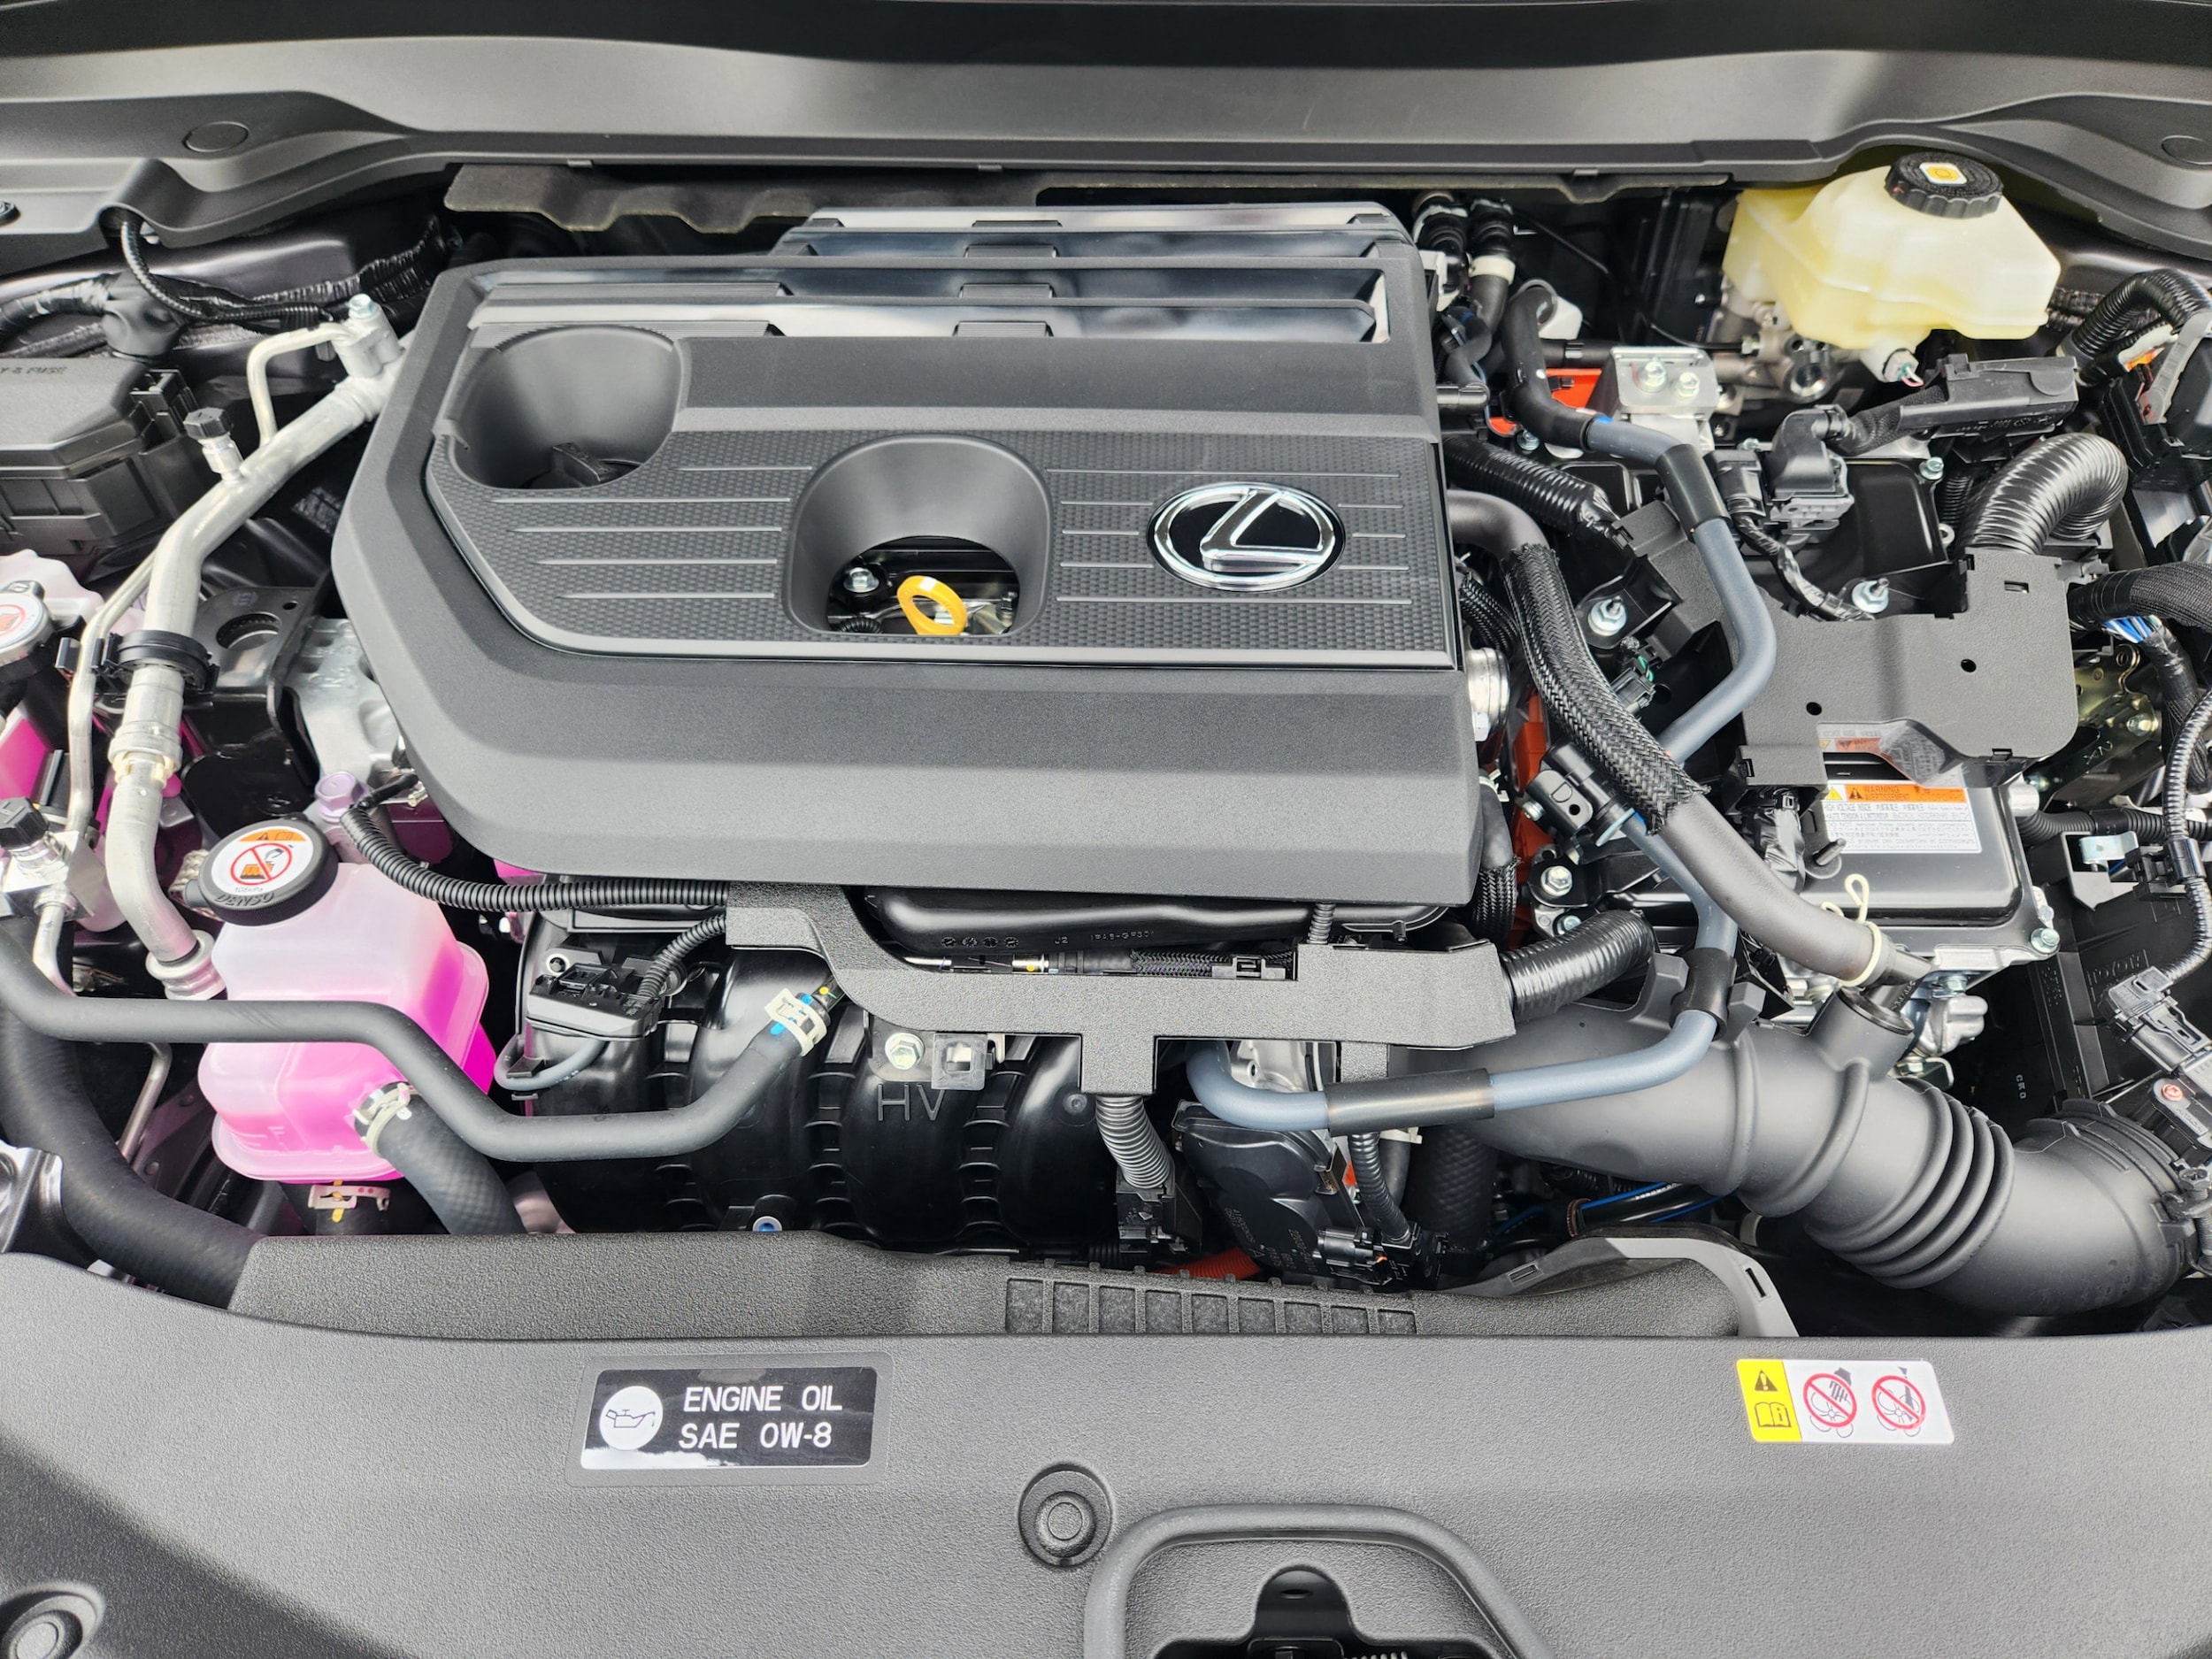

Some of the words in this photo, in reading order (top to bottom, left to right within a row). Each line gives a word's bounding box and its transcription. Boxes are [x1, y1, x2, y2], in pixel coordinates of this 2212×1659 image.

[214, 892, 275, 907] DENSO
[876, 1082, 946, 1122] HV
[683, 1385, 784, 1412] ENGINE
[802, 1385, 843, 1412] OIL
[679, 1422, 741, 1449] SAE
[759, 1421, 833, 1449] 0W-8
